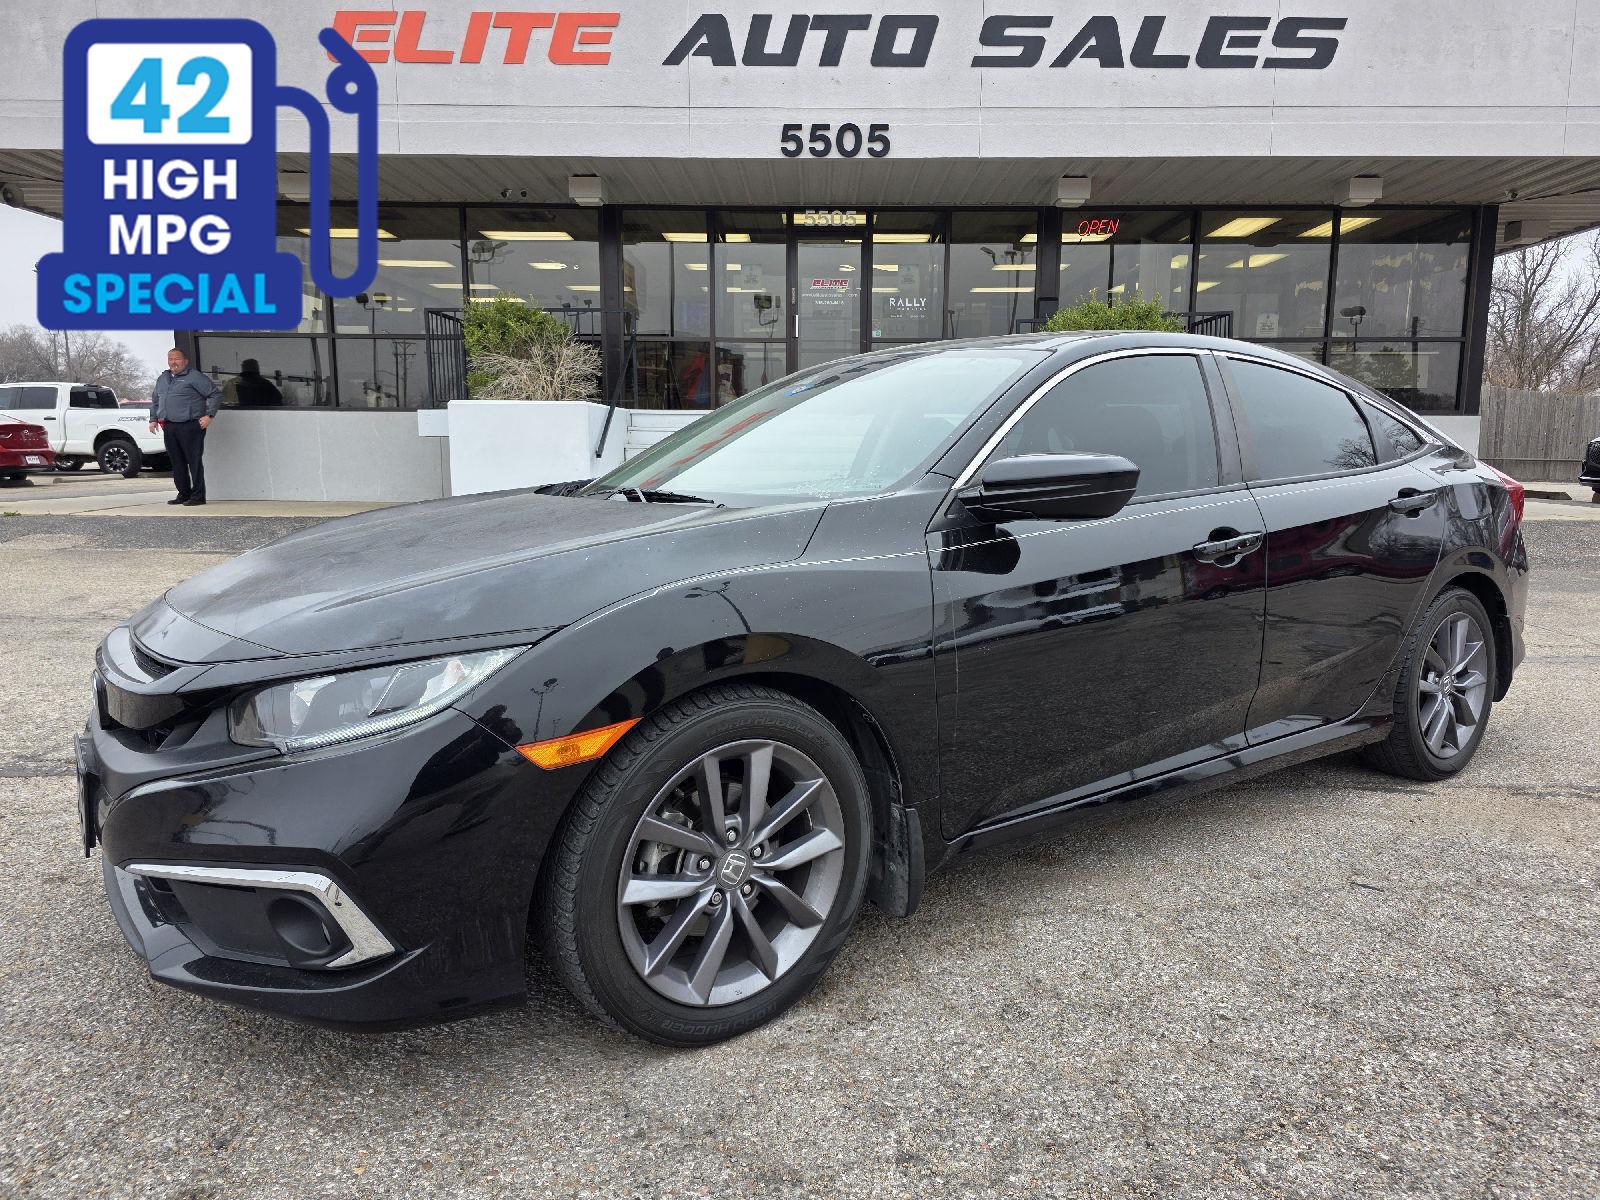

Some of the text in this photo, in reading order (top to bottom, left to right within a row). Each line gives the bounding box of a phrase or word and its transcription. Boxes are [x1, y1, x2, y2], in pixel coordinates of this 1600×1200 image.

[328, 11, 1347, 69] ELITE AUTO SALES
[781, 123, 890, 157] 5505
[804, 210, 857, 226] 5505
[1078, 219, 1119, 236] OPEN
[889, 298, 927, 307] RALLY
